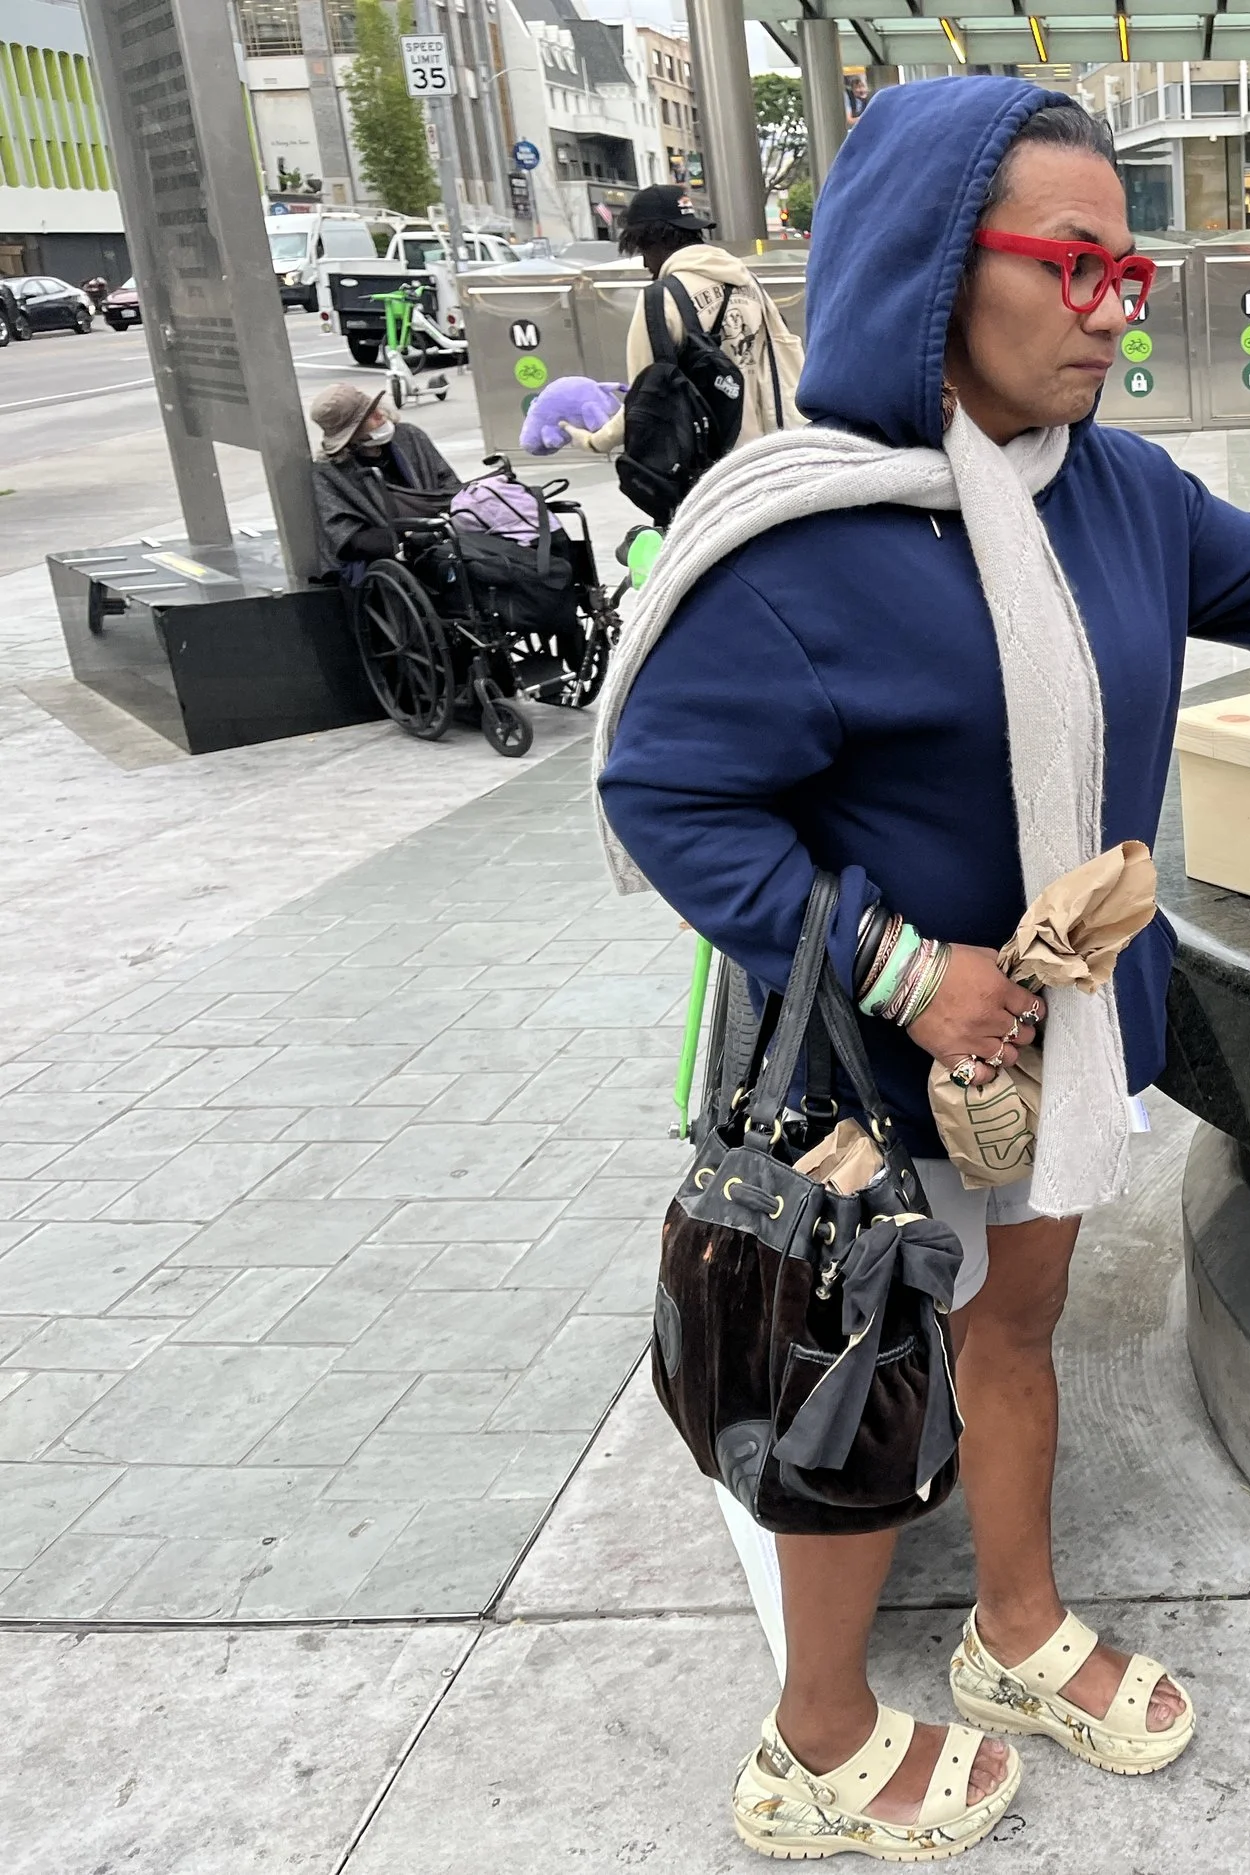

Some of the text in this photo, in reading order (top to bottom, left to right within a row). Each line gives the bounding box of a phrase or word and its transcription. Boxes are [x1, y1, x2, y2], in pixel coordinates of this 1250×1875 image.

[405, 42, 443, 52] SPEED
[411, 54, 440, 65] LIMIT
[413, 68, 446, 89] 35
